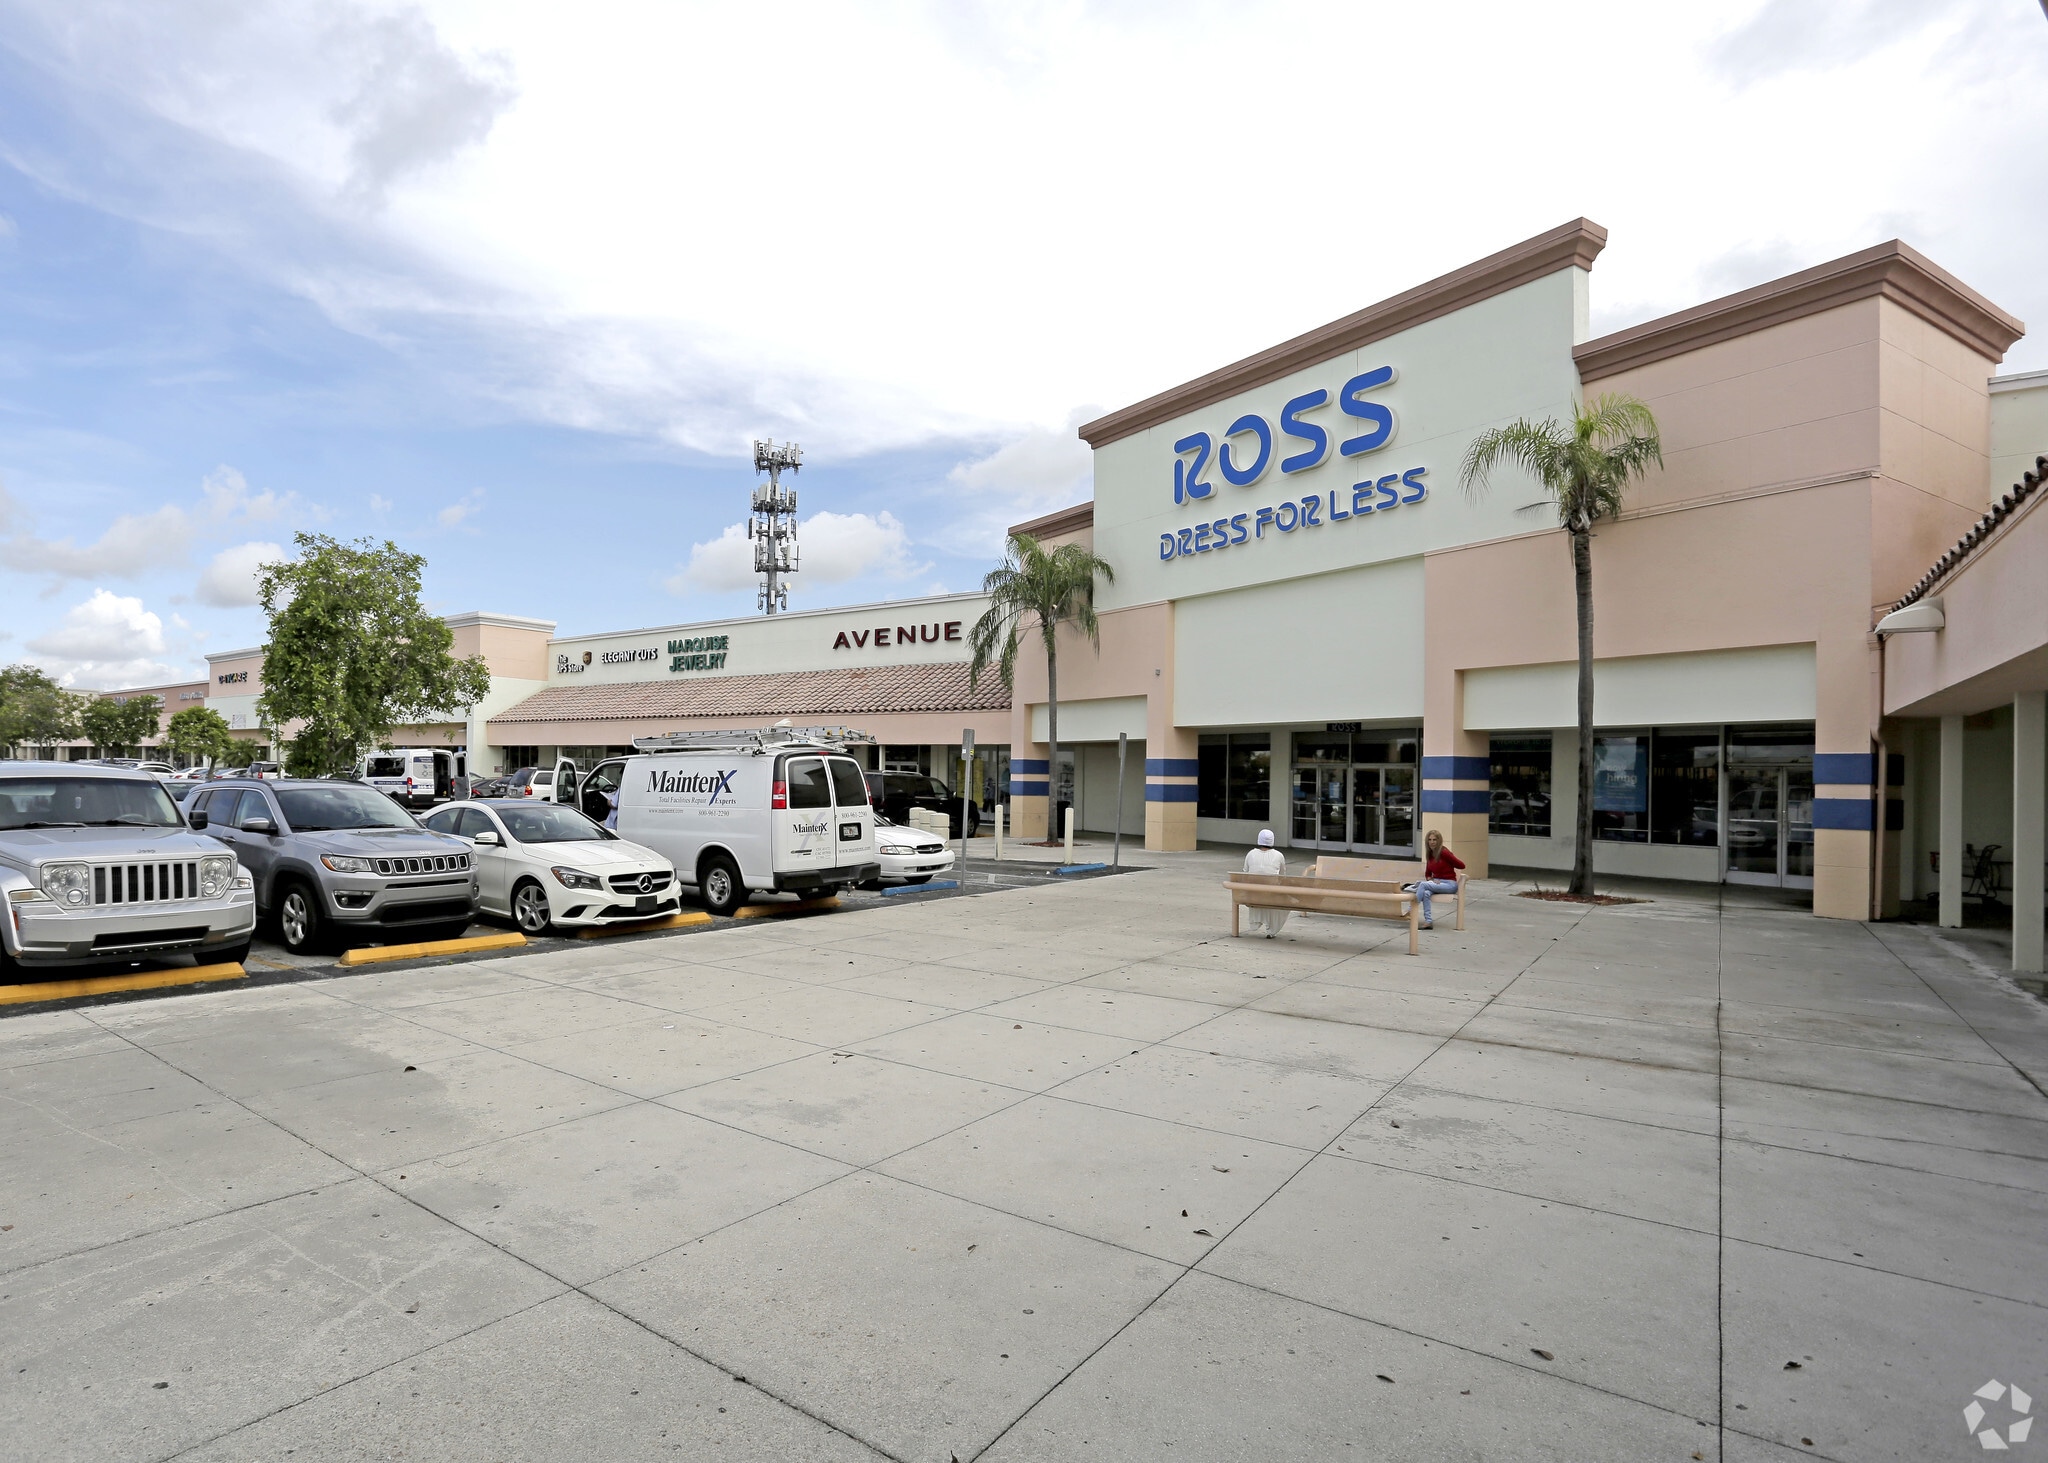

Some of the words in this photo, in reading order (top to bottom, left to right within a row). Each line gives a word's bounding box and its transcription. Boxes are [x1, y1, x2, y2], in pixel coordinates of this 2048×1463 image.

[1173, 364, 1399, 506] ROSS
[1159, 512, 1251, 562] DRESS
[1255, 493, 1324, 541] FOR
[1328, 465, 1429, 523] LESS
[832, 620, 963, 650] AVENUE
[668, 635, 729, 653] MARQUISE
[557, 654, 569, 664] The
[600, 650, 637, 665] ELEGANT
[637, 647, 659, 662] CUTS
[668, 652, 728, 673] JEWELRY
[557, 663, 569, 674] UPS
[568, 663, 585, 673] Store
[1331, 721, 1356, 733] ROSS
[646, 769, 738, 803] MaintenX
[1606, 772, 1638, 785] hiring
[670, 796, 691, 804] Facilities
[691, 797, 707, 805] Repair
[715, 797, 737, 806] Experts
[698, 809, 730, 817] 800-961-2290
[793, 822, 828, 836] MaintenX
